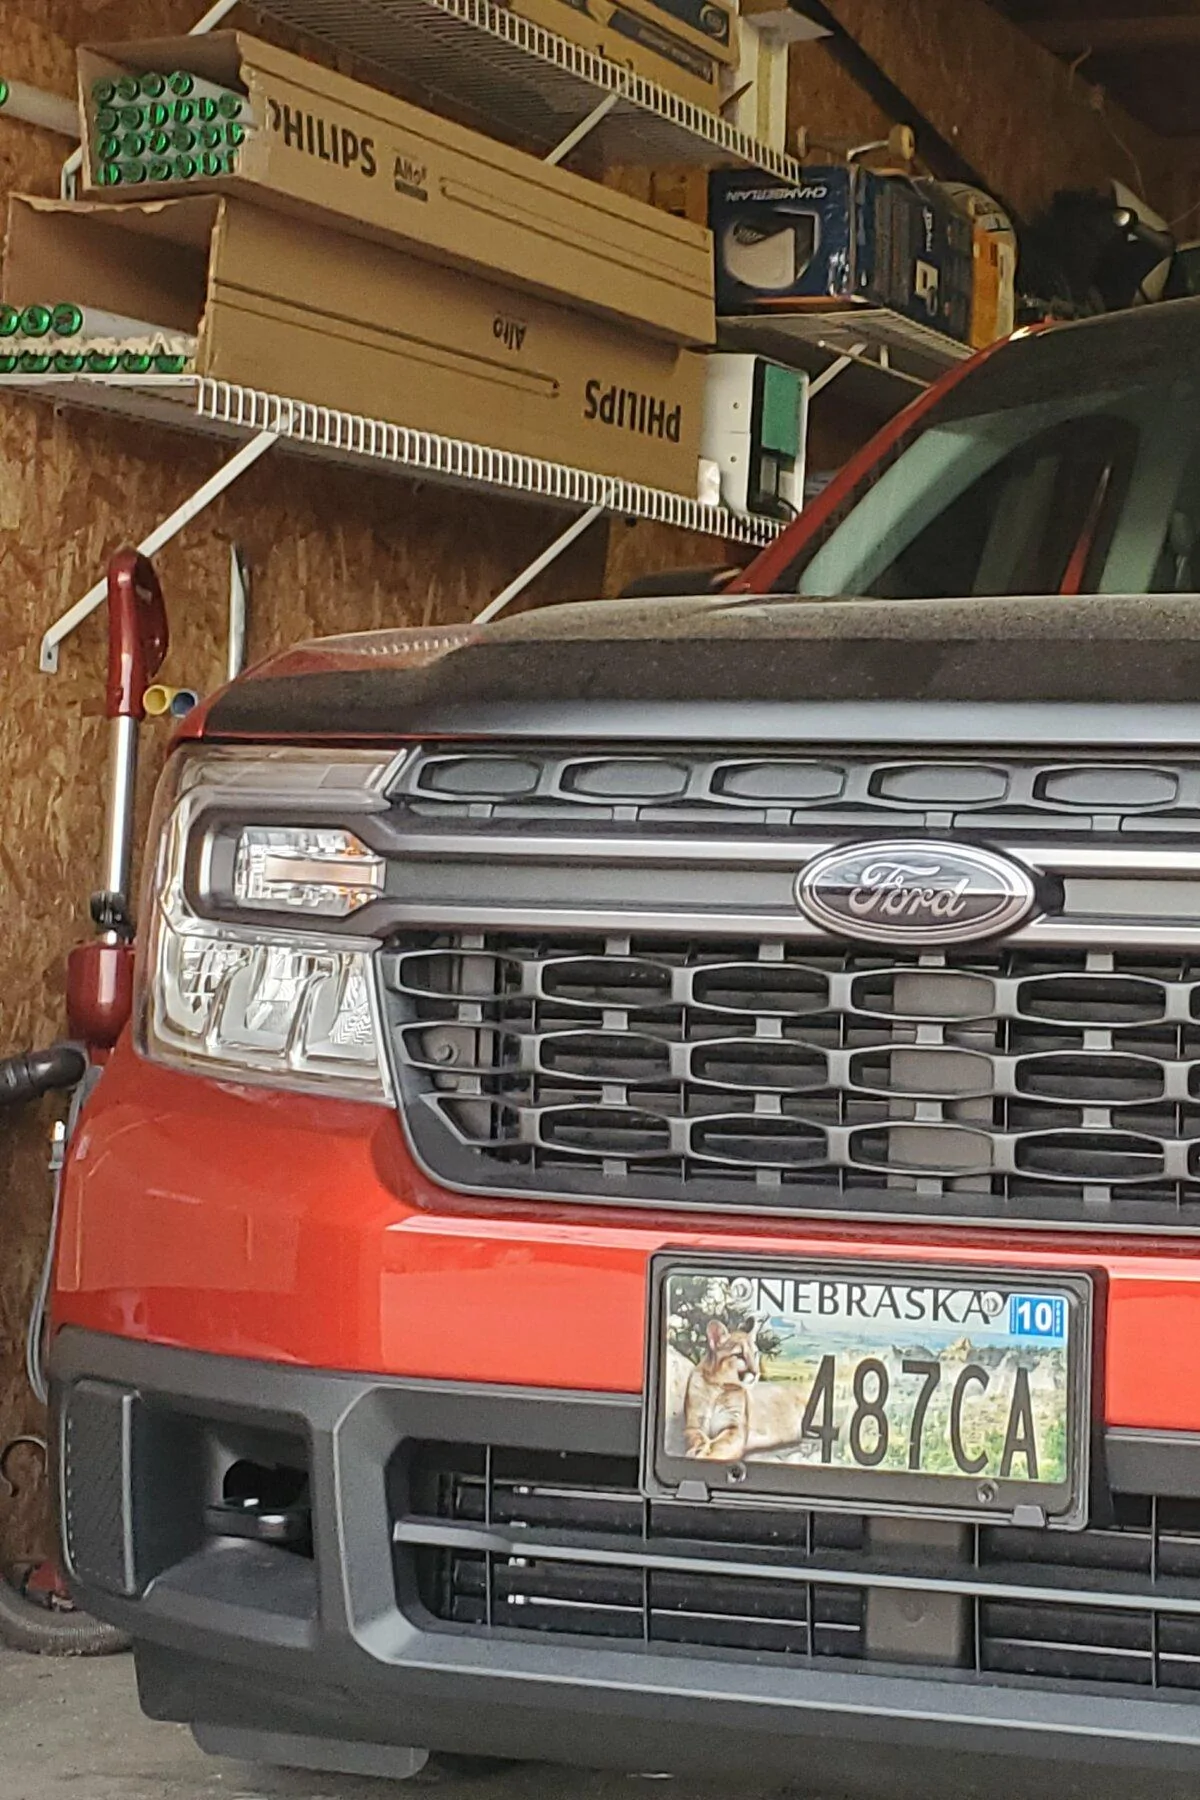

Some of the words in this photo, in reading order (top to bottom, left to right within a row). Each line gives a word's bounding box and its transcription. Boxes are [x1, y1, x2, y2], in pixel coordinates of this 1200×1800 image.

[584, 379, 681, 443] PHILIPS
[848, 861, 970, 918] Ford
[754, 1278, 994, 1326] NEBRASKA
[1018, 1301, 1053, 1332] 10
[801, 1354, 1040, 1479] 487CA
